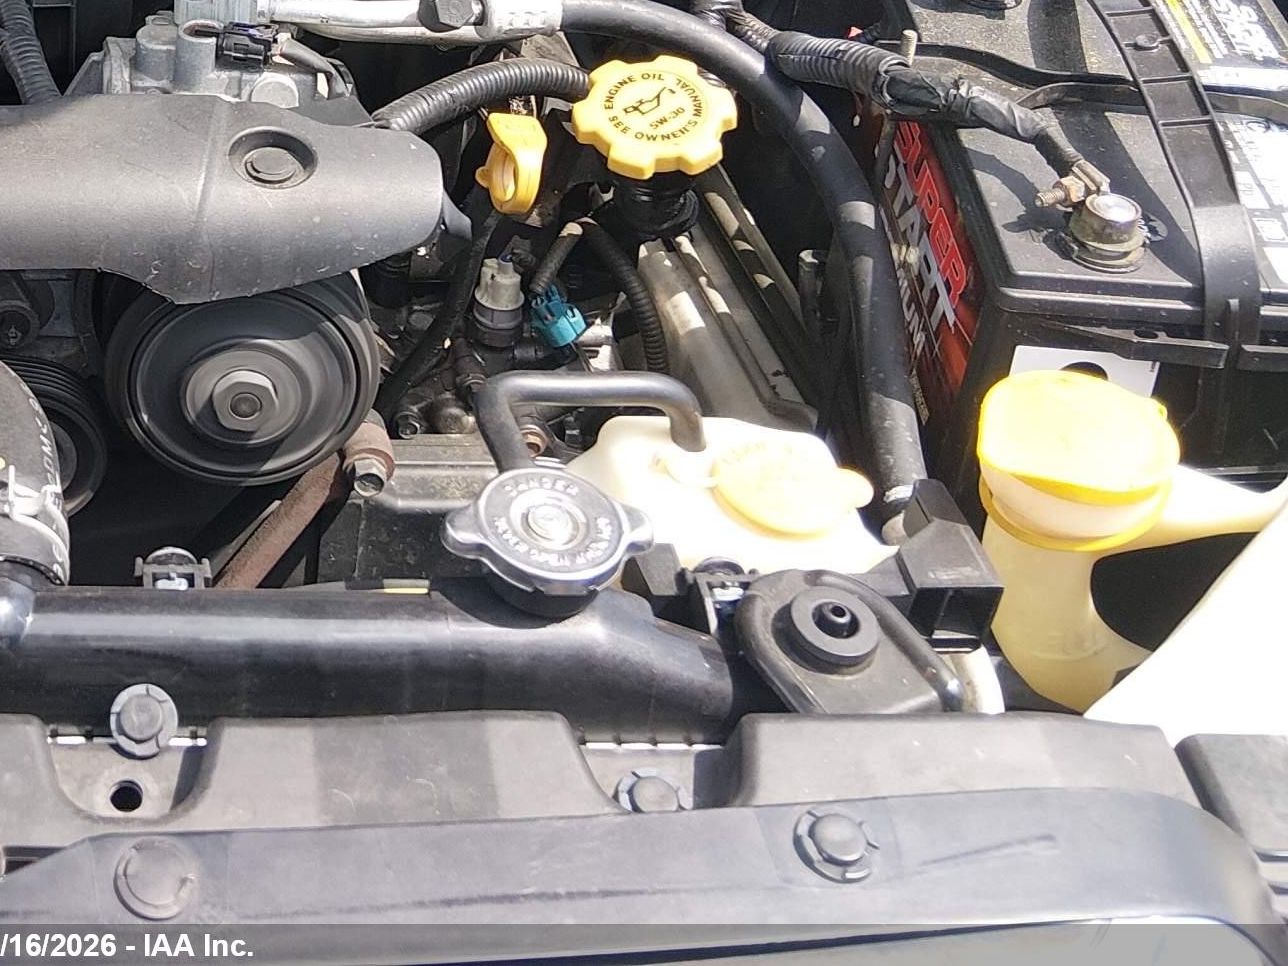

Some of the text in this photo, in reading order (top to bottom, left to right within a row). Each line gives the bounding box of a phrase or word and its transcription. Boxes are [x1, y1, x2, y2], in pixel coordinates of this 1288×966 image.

[604, 72, 665, 111] ENGINE OIL
[608, 78, 704, 142] SEE OWNER'S MANUAL
[884, 141, 956, 333] START
[894, 121, 967, 308] SUPER
